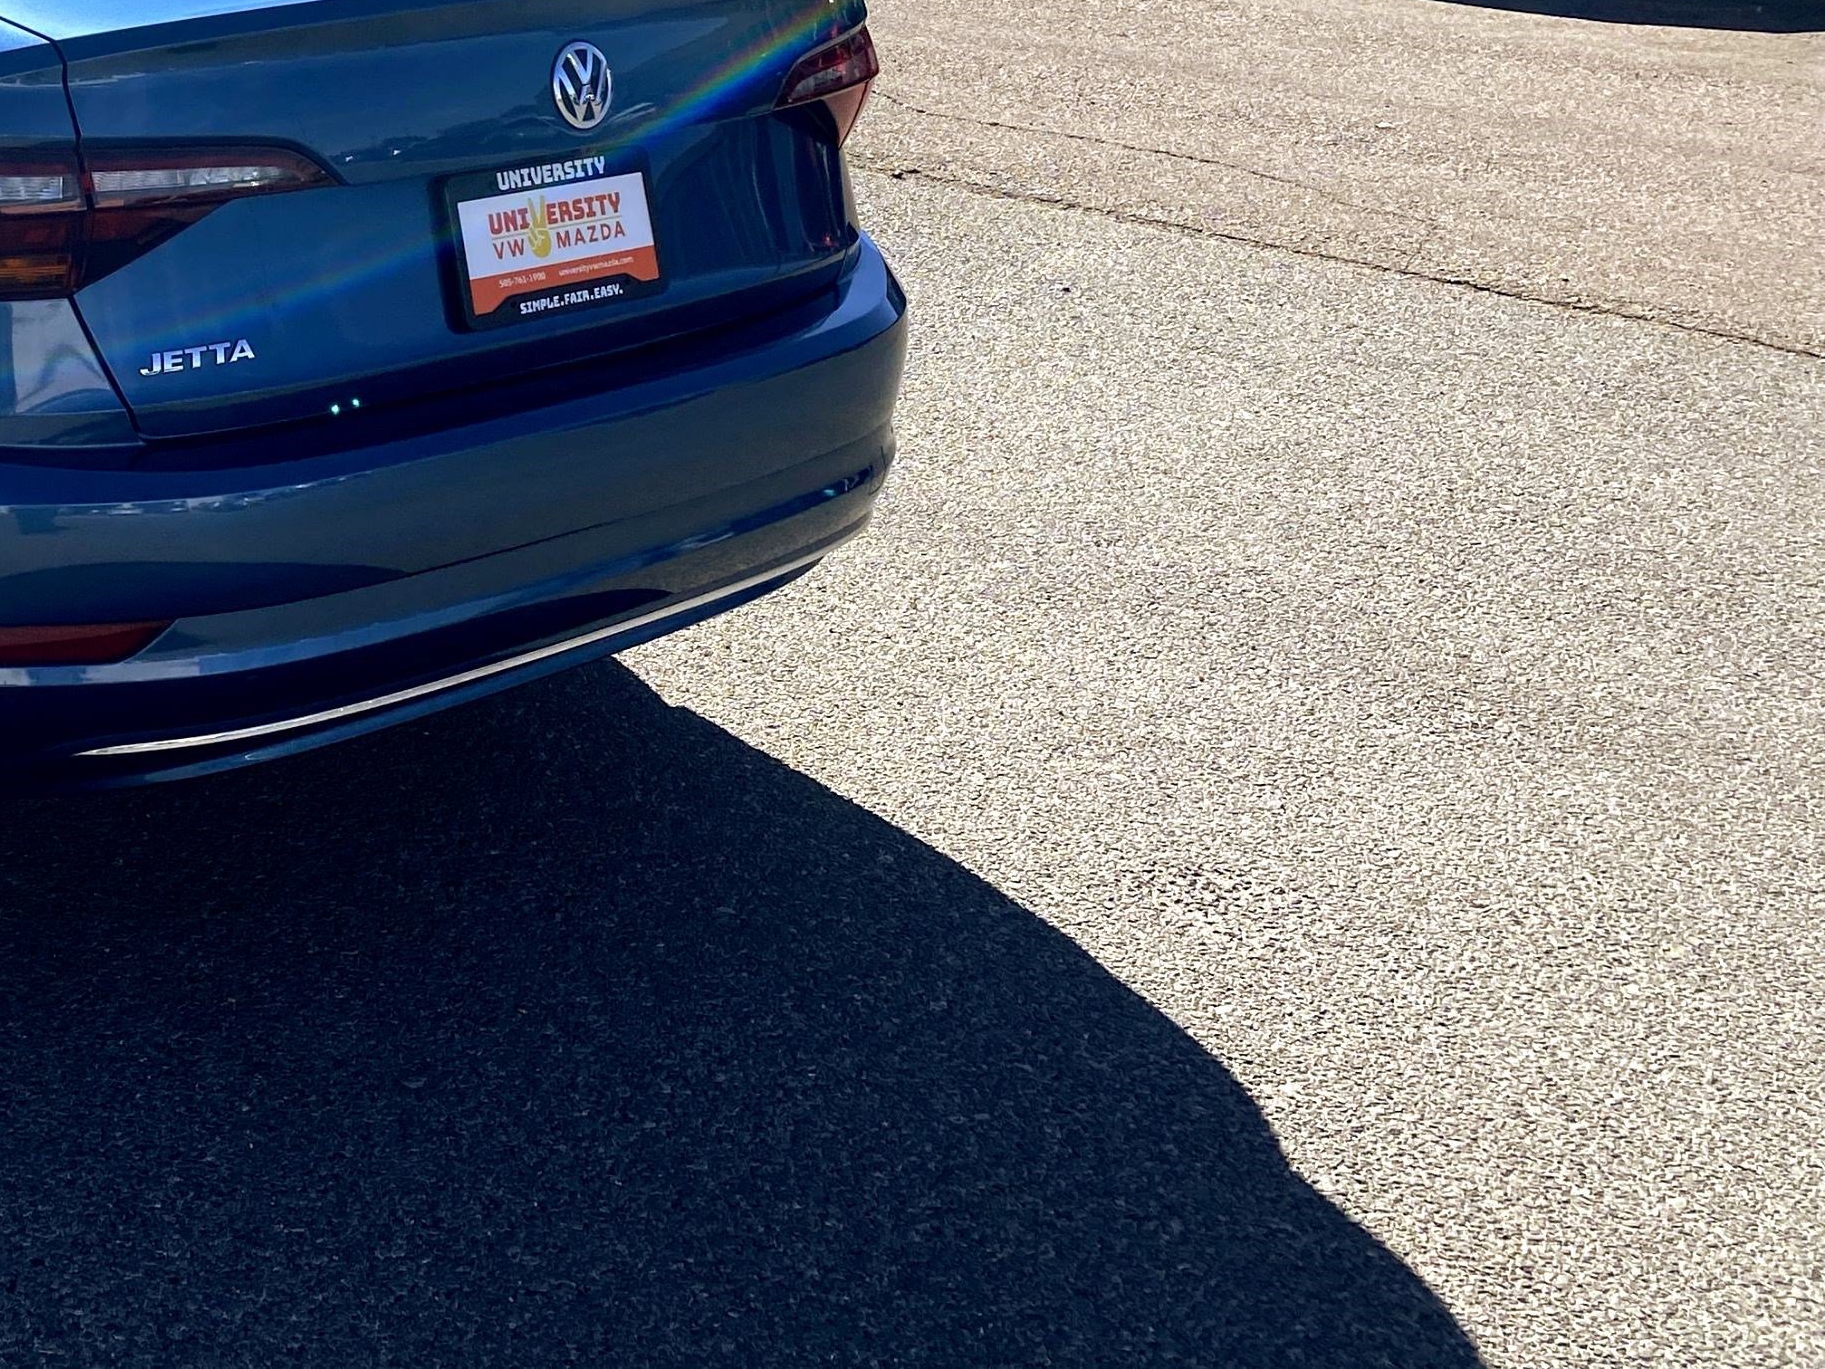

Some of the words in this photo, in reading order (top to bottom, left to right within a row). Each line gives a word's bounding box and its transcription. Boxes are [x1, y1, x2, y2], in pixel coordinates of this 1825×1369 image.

[496, 155, 605, 190] UNIVERSITY
[488, 191, 621, 235] UNIVERSITY
[493, 238, 525, 260] VW
[556, 221, 626, 249] MAZDA
[139, 339, 256, 377] JETTA
